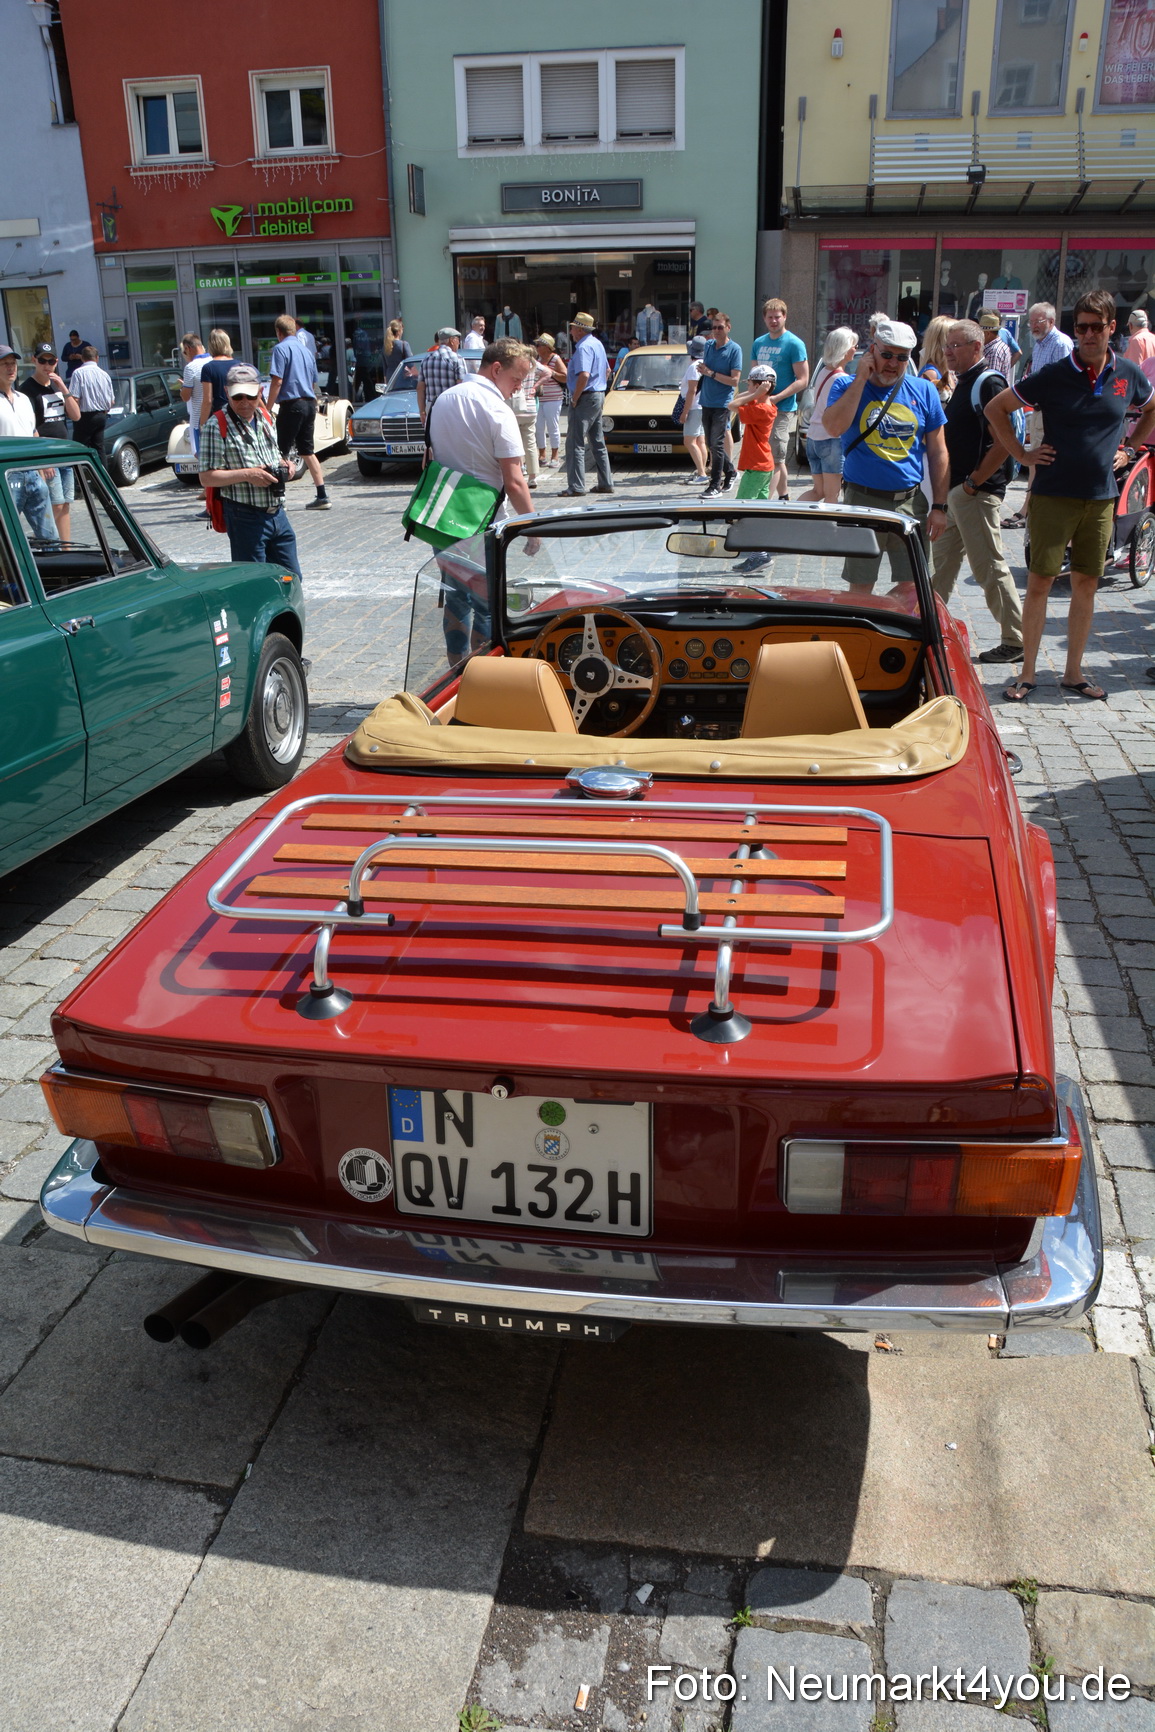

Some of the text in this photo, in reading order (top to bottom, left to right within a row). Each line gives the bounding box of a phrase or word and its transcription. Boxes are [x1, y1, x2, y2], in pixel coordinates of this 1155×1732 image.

[1104, 62, 1155, 73] WIR FEIER
[1104, 74, 1124, 85] DAS
[541, 186, 600, 205] BONITA
[257, 197, 353, 216] mobilcom
[259, 218, 315, 236] debitel
[199, 278, 233, 289] GRAVIS
[844, 297, 871, 311] WIR
[638, 445, 648, 453] RH
[401, 1117, 414, 1133] D
[434, 1089, 474, 1149] N
[401, 1152, 469, 1211] QV
[428, 1307, 600, 1336] TRIUMPH
